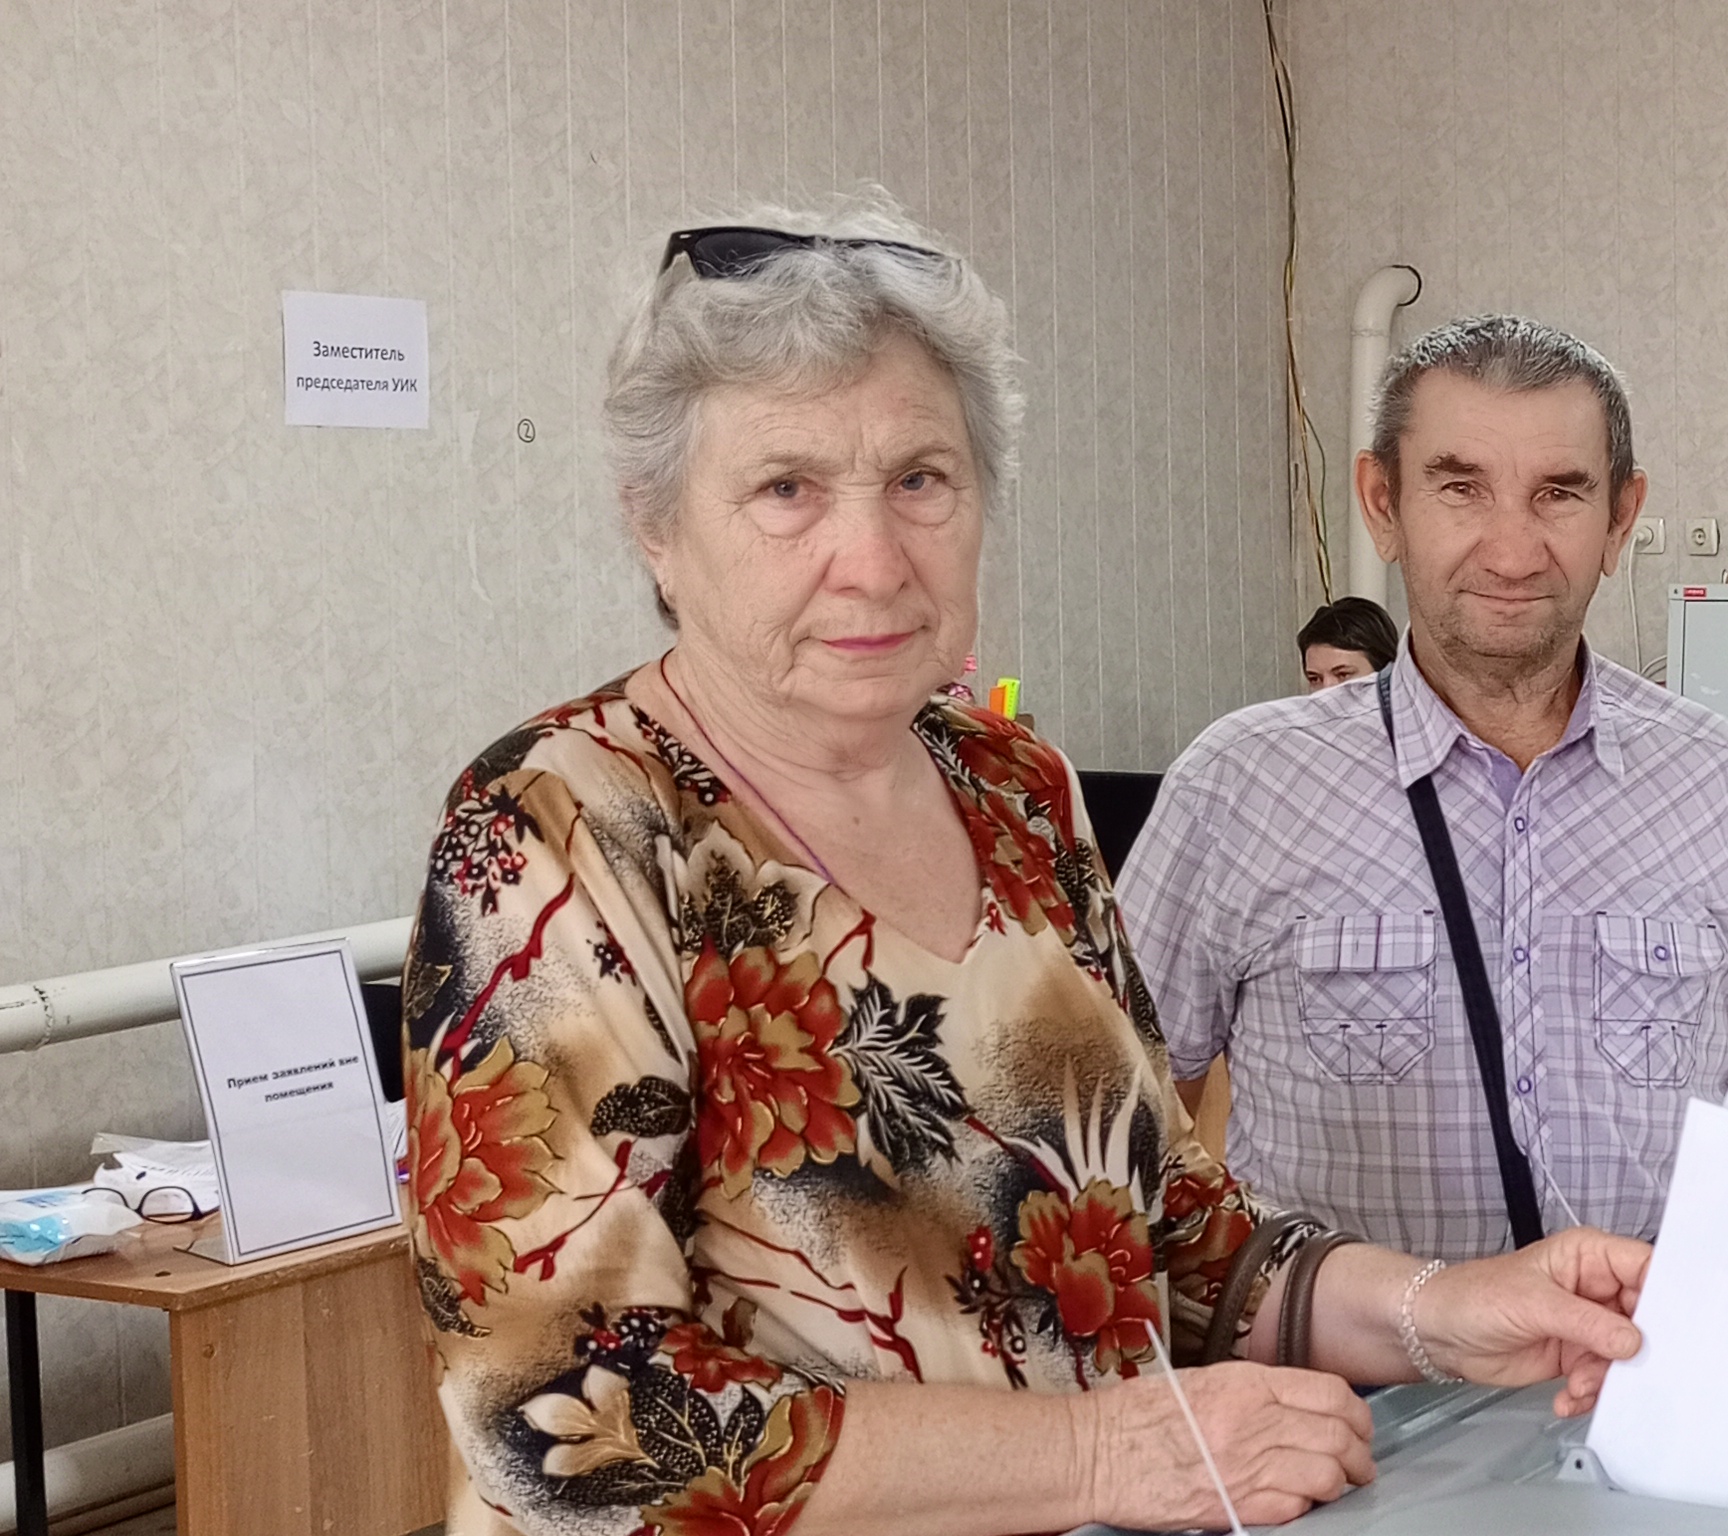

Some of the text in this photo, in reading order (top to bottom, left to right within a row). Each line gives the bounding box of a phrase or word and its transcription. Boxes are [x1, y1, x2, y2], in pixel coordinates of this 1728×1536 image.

[313, 340, 406, 362] Заместитель
[296, 375, 418, 393] председателя УИК
[227, 1053, 360, 1090] Прием заявлений вне
[264, 1080, 334, 1103] помещения
